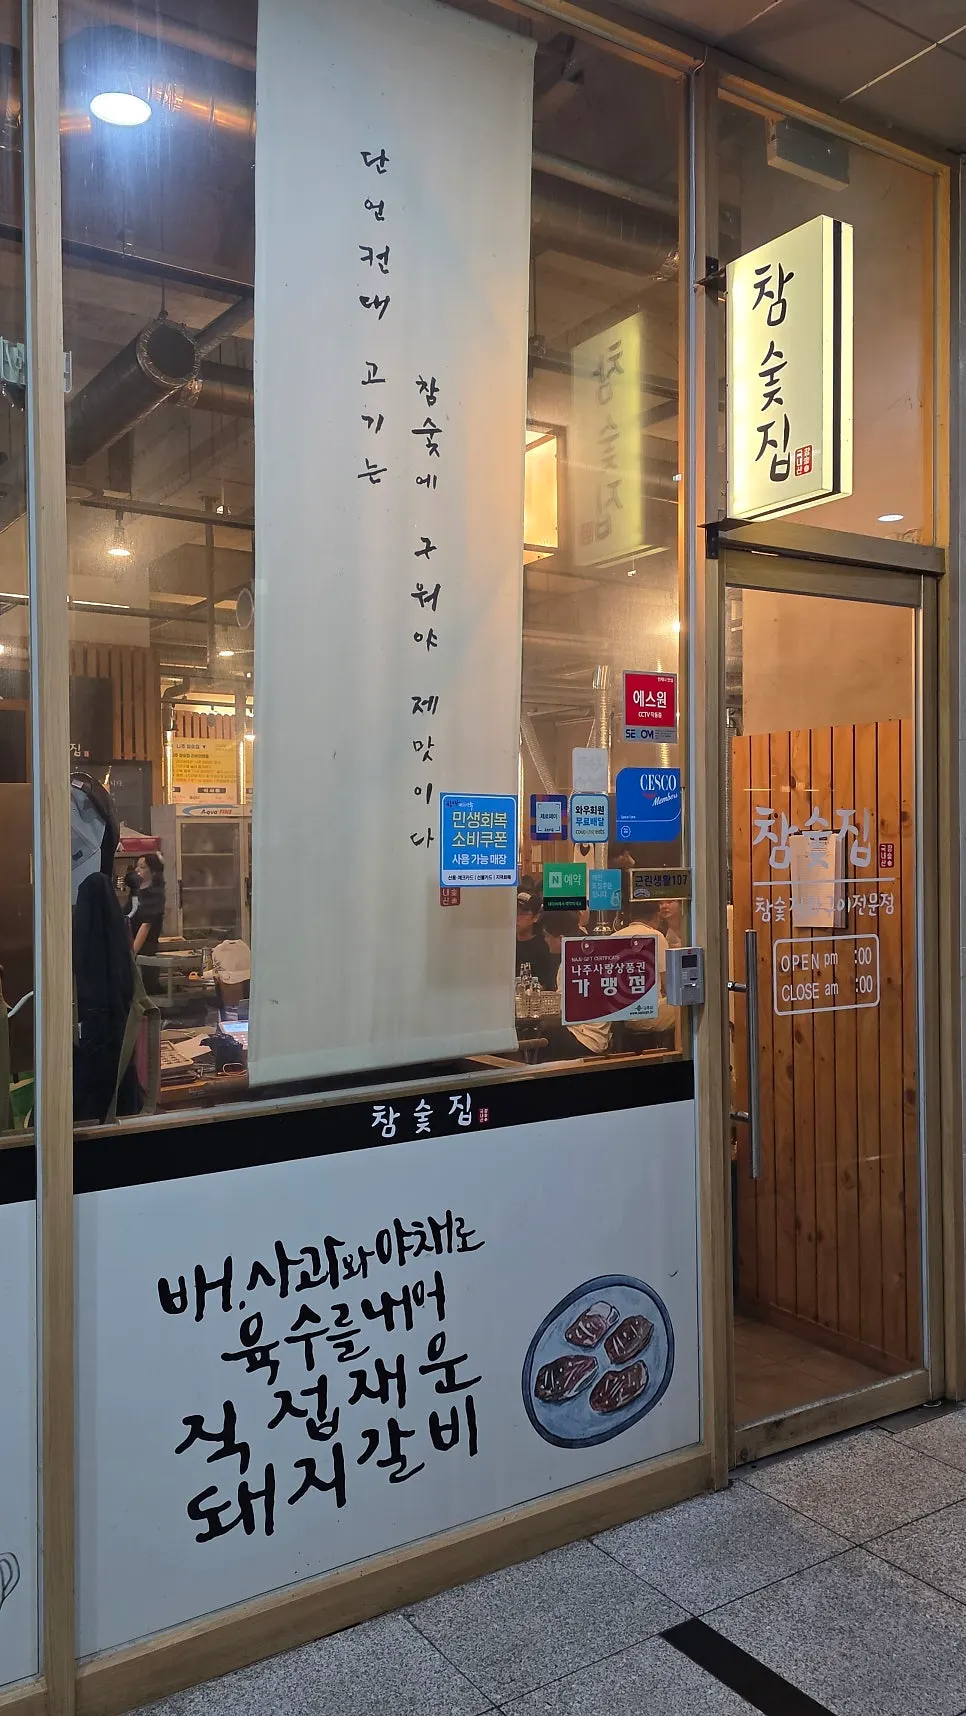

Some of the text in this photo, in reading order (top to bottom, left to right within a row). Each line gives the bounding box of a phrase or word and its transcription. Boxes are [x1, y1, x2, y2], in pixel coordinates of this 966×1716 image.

[357, 148, 391, 485] 단언컨대 고기는
[752, 262, 795, 482] 참숯집
[411, 374, 443, 490] 참숯에
[410, 536, 442, 652] 구워야
[633, 690, 667, 708] 에스원
[640, 774, 677, 791] CESCO
[652, 792, 678, 807] Members
[453, 811, 507, 828] 민생회복
[575, 805, 605, 816] 와우회원
[575, 817, 605, 827] 무료배달
[452, 831, 507, 848] 소비쿠폰
[753, 806, 871, 869] 참숯집
[452, 854, 507, 865] 사용 가능 매장
[564, 873, 582, 886] 예약
[571, 961, 646, 976] 나주사랑상품권
[781, 947, 872, 972] OPEN pm :00
[571, 975, 646, 998] 가맹점
[782, 975, 873, 1002] CLOSE am :00
[371, 1092, 473, 1138] 참숯집
[186, 1394, 480, 1544] 돼지갈비
